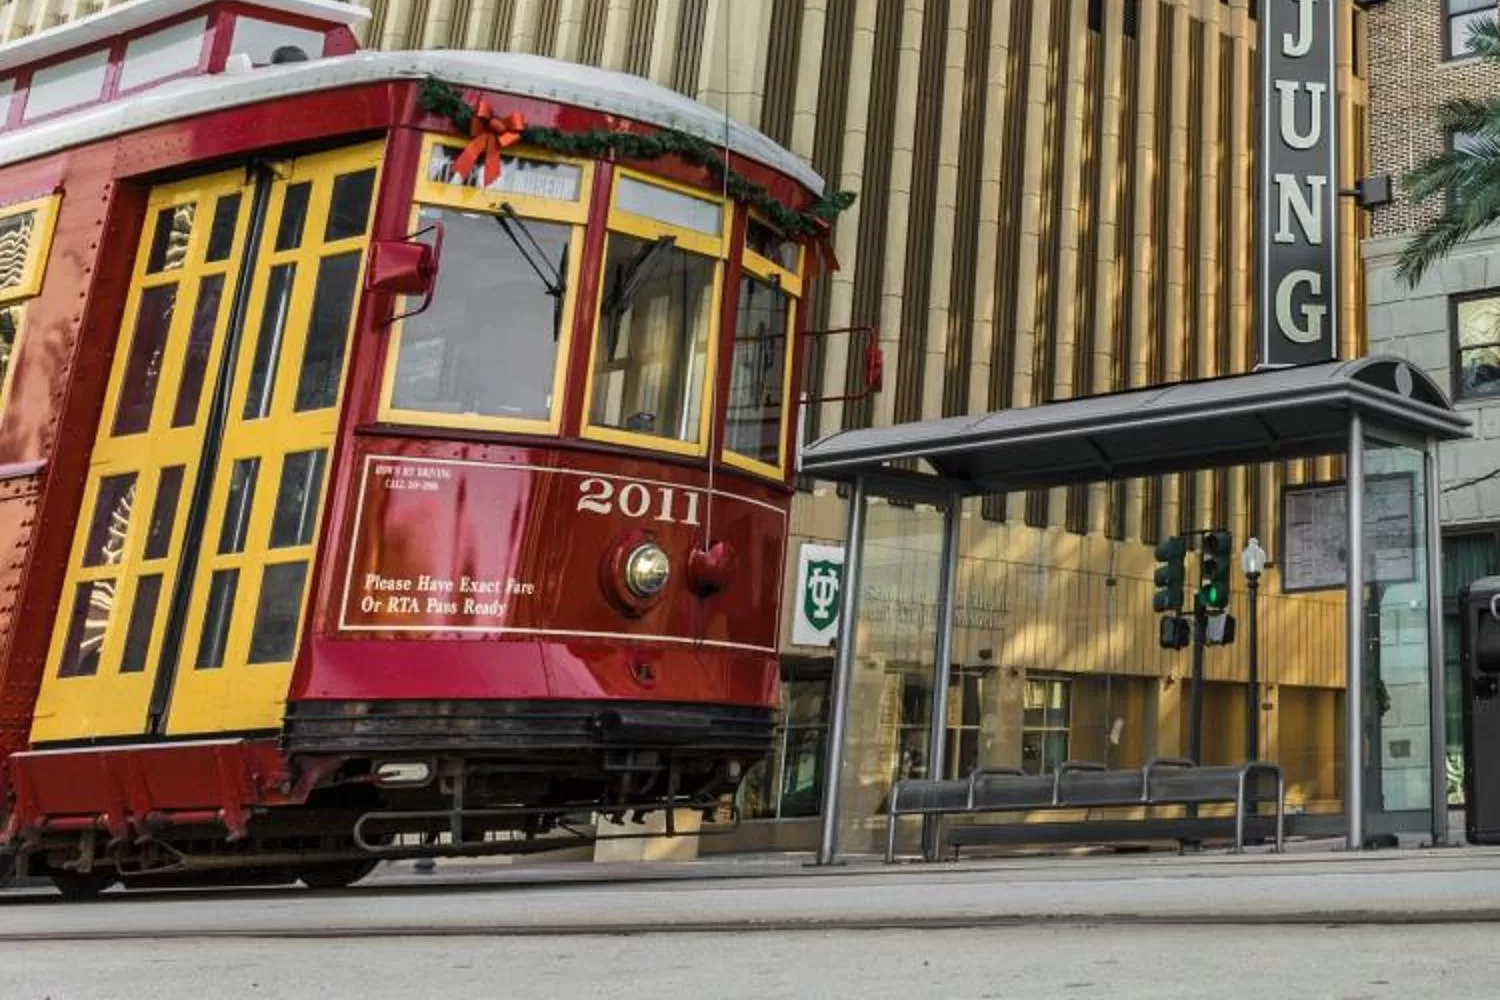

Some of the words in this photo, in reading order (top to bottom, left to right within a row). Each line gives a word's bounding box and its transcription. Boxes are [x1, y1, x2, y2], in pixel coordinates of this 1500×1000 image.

[576, 478, 700, 526] 2011
[364, 573, 412, 592] Please
[416, 574, 454, 593] Have
[459, 575, 501, 595] Exact
[504, 577, 536, 595] Fare
[361, 595, 384, 613] Or
[386, 597, 420, 613] RTA
[426, 597, 458, 615] Pass
[463, 598, 508, 617] Ready
